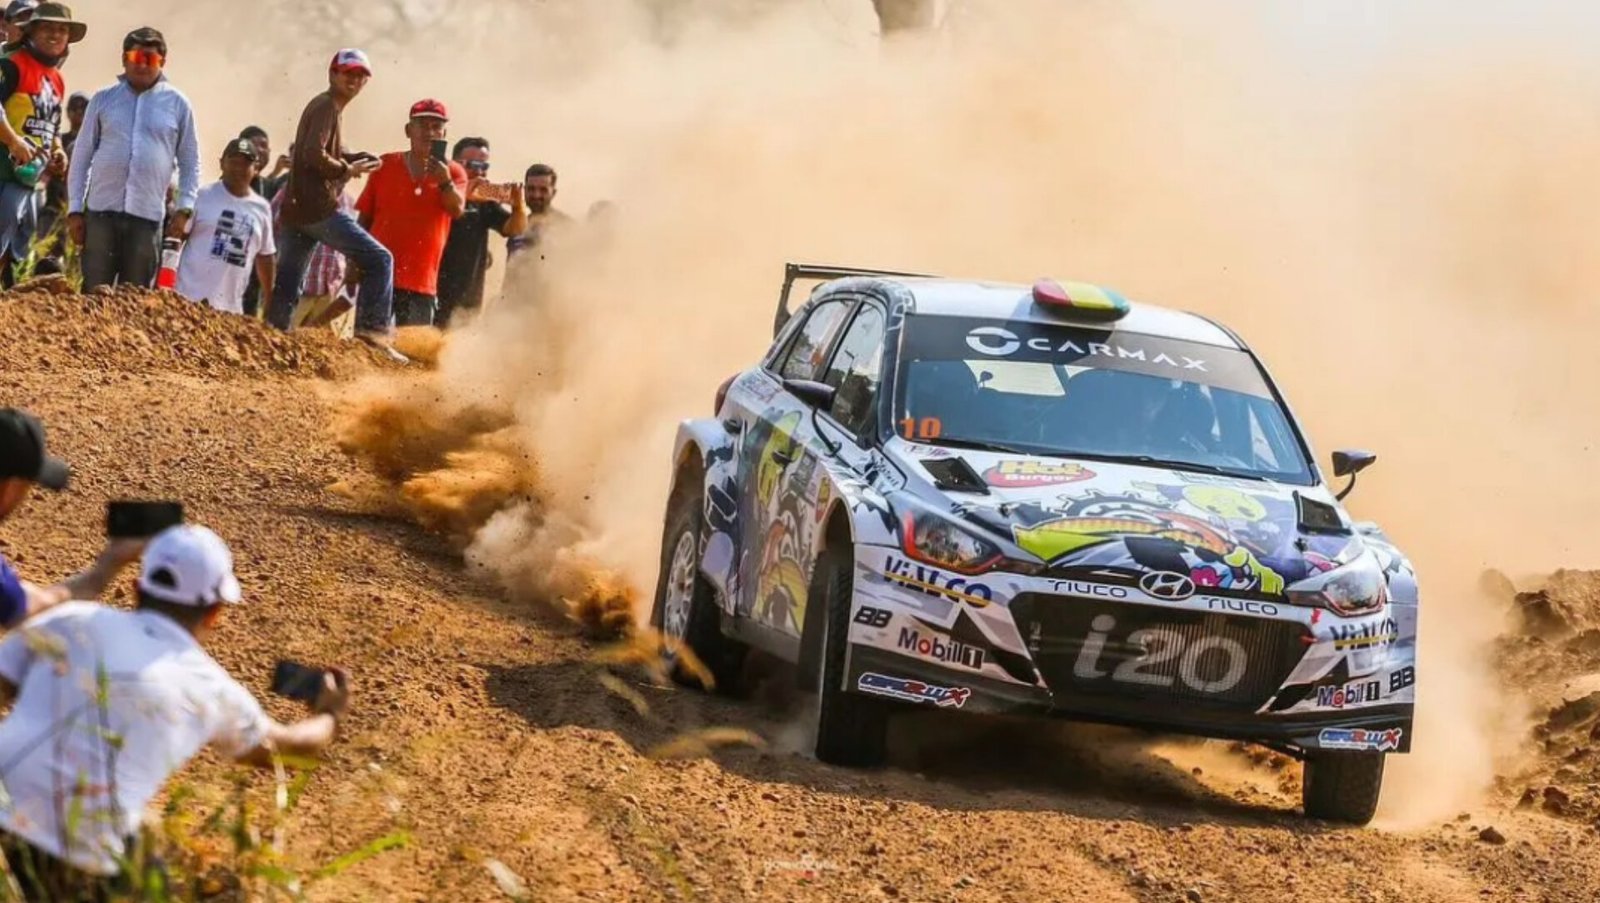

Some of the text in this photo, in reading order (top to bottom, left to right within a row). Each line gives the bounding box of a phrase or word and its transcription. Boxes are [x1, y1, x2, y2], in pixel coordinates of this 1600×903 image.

[1027, 338, 1208, 373] CARMAX
[899, 416, 942, 440] 10
[997, 460, 1085, 475] Hot
[853, 605, 893, 629] BB
[897, 626, 982, 669] Mobil 1
[1072, 613, 1248, 693] i20
[1389, 665, 1415, 693] BB
[1316, 681, 1379, 708] Mobil 1
